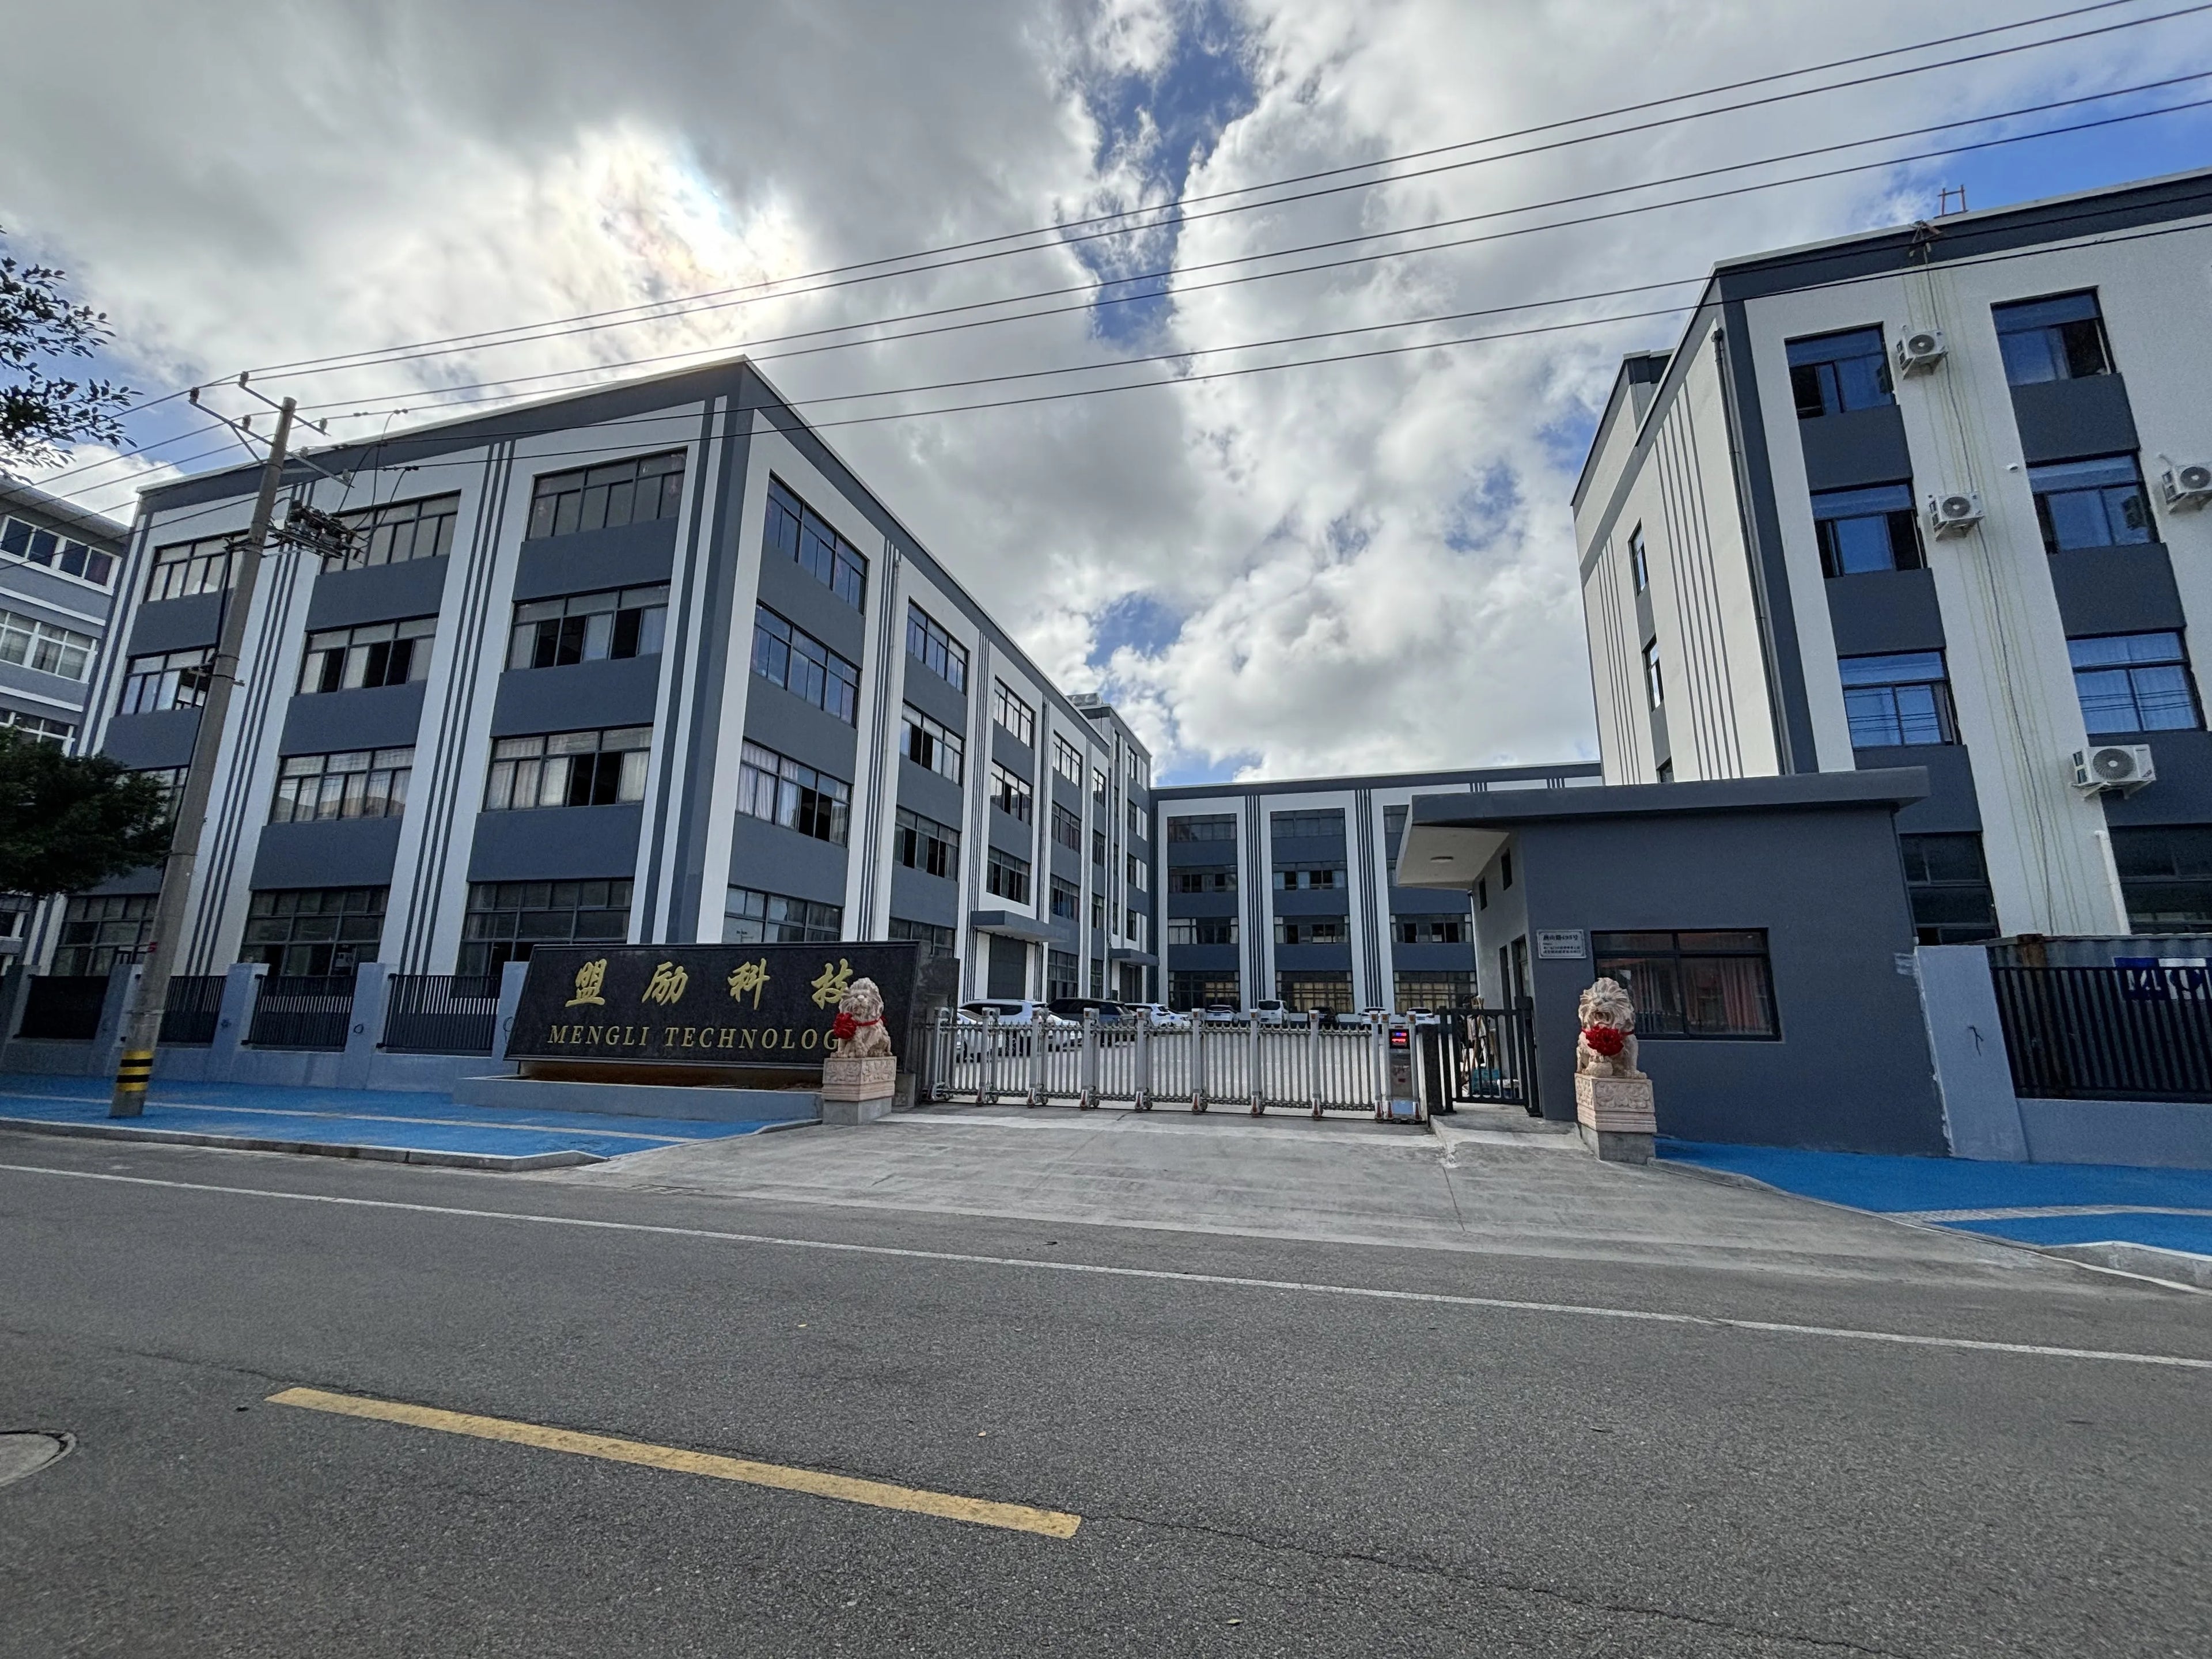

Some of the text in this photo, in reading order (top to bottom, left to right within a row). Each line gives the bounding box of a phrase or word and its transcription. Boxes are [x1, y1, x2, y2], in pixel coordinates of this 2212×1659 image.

[565, 958, 853, 1010] 盟励科技
[548, 1025, 839, 1050] MENGLI TECHNOLOG
